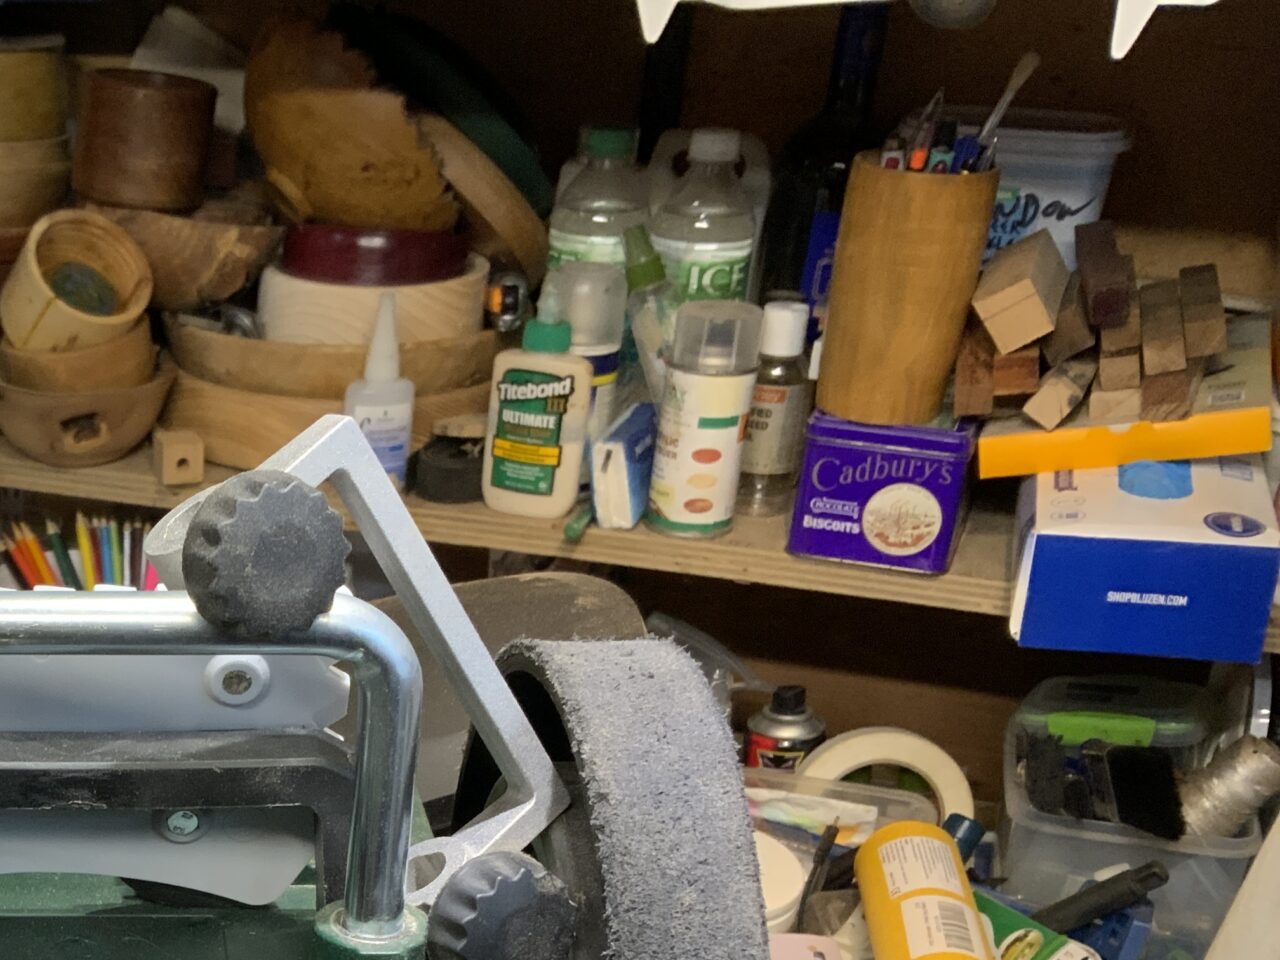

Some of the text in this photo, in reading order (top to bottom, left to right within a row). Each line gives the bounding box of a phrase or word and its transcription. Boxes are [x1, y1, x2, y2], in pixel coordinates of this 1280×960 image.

[498, 378, 572, 400] Titebond
[502, 408, 557, 429] ULTIMATE
[811, 453, 954, 492] Cadbury's
[802, 514, 861, 534] BISCUITS
